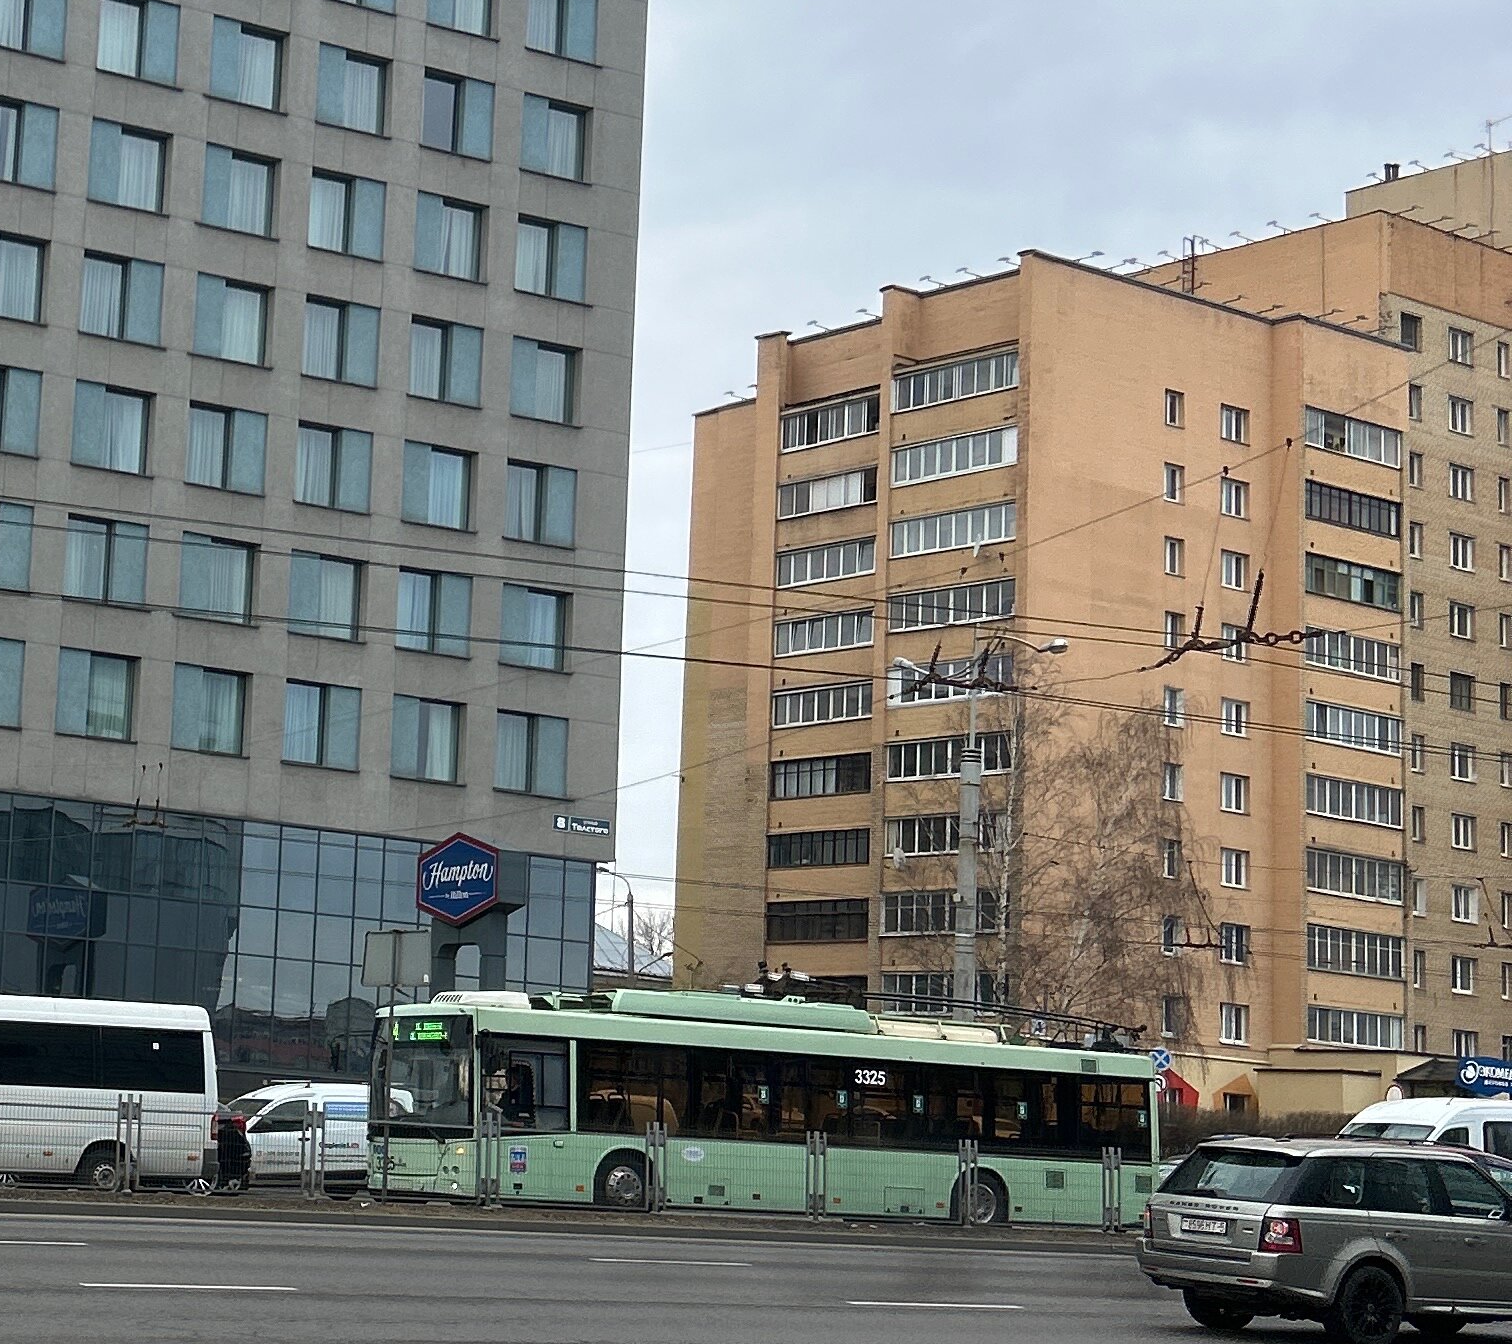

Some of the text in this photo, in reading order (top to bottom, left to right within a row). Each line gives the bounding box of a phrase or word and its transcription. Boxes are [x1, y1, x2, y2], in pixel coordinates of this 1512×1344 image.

[556, 816, 566, 829] 8
[422, 860, 494, 890] Hampton
[854, 1069, 886, 1086] 3325
